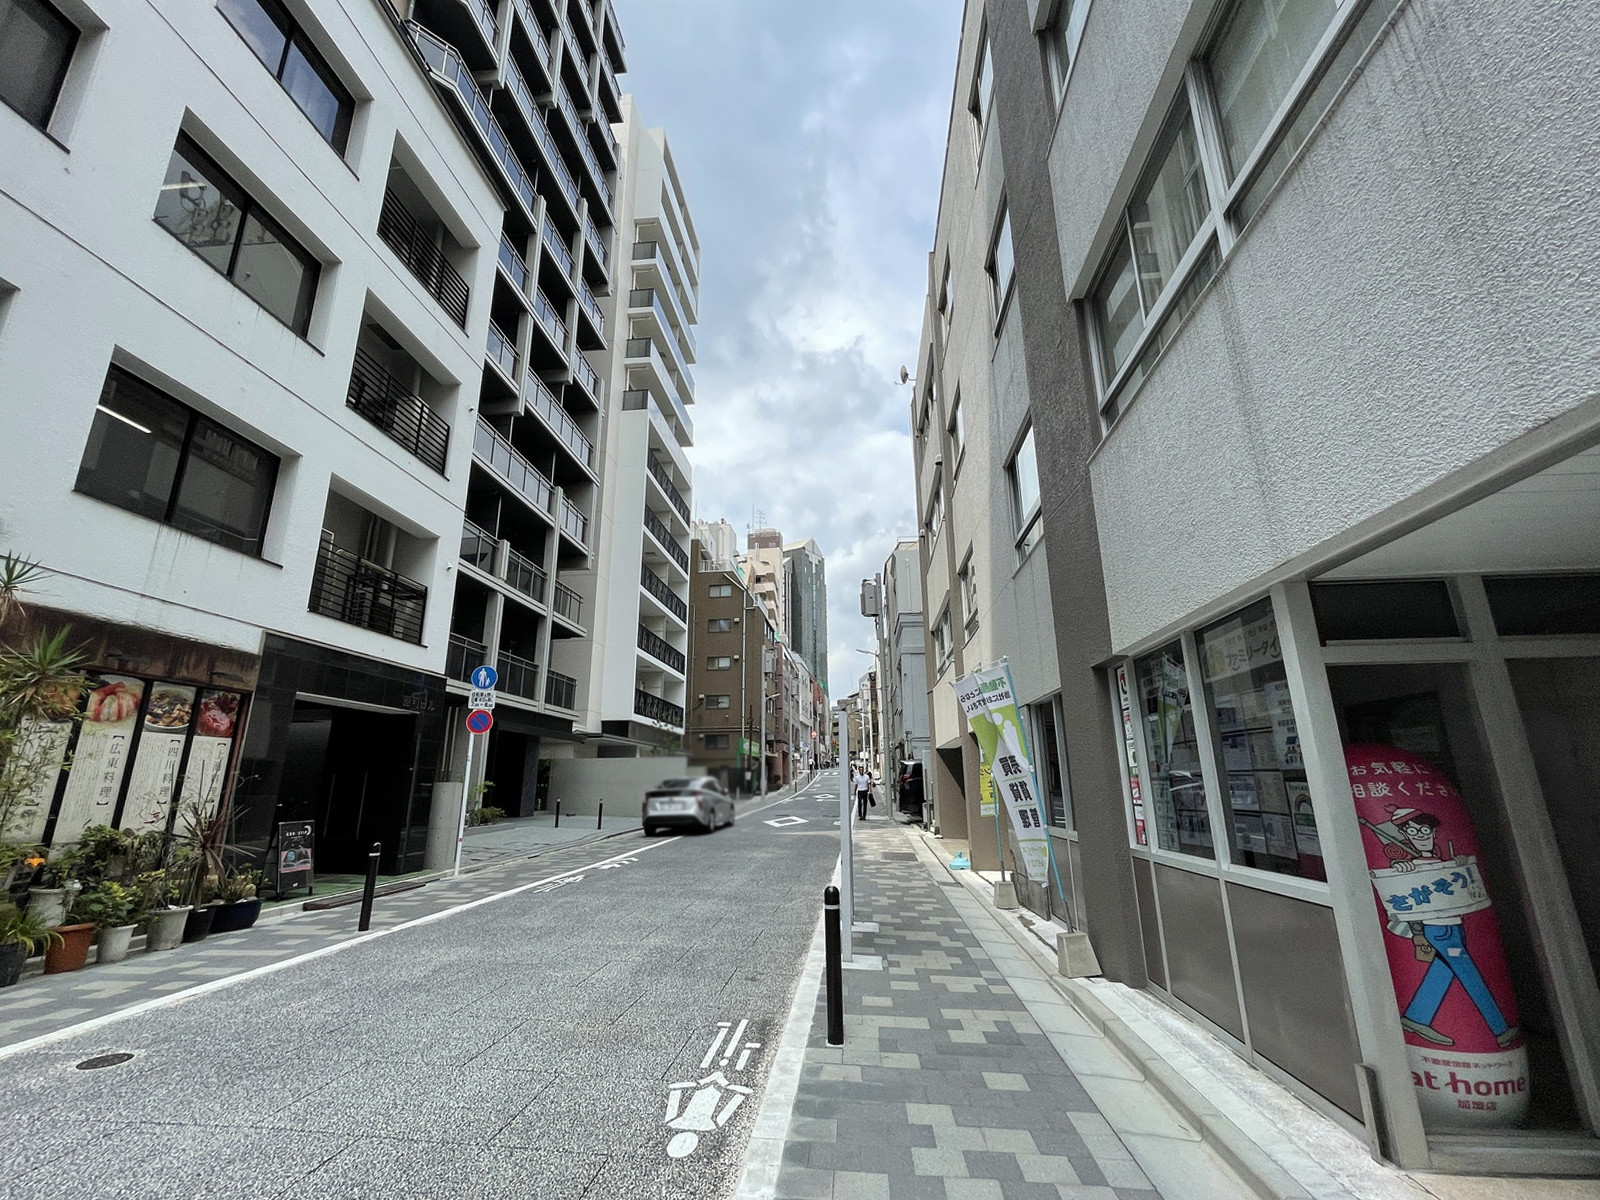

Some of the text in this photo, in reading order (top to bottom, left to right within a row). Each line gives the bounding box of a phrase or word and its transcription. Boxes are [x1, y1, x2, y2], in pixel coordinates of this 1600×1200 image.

[1350, 761, 1430, 776] お気軽に
[1411, 1070, 1526, 1096] at home
